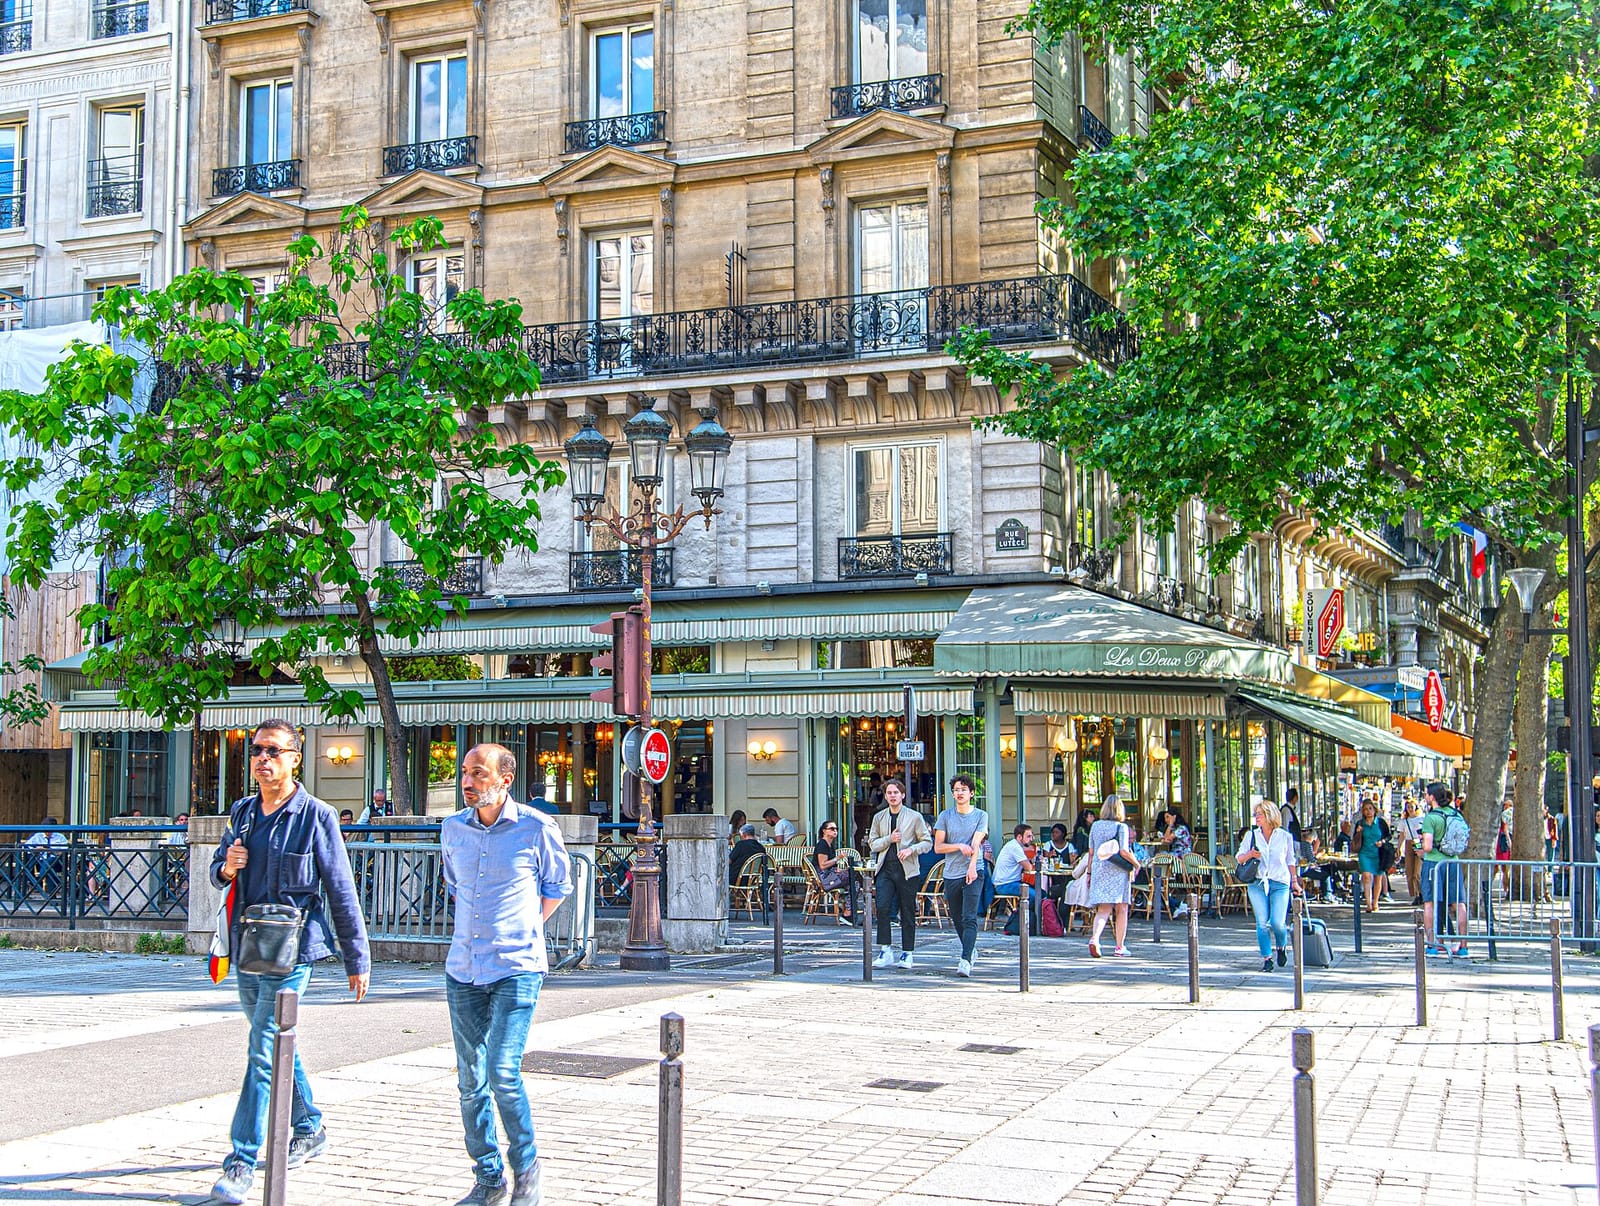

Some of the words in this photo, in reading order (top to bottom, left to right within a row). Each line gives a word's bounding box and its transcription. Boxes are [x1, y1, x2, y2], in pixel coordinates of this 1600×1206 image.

[1325, 606, 1338, 640] TABAC
[1358, 633, 1376, 651] AFE
[1103, 646, 1135, 667] Les
[1138, 647, 1181, 667] Deux
[1428, 675, 1439, 727] TABAC
